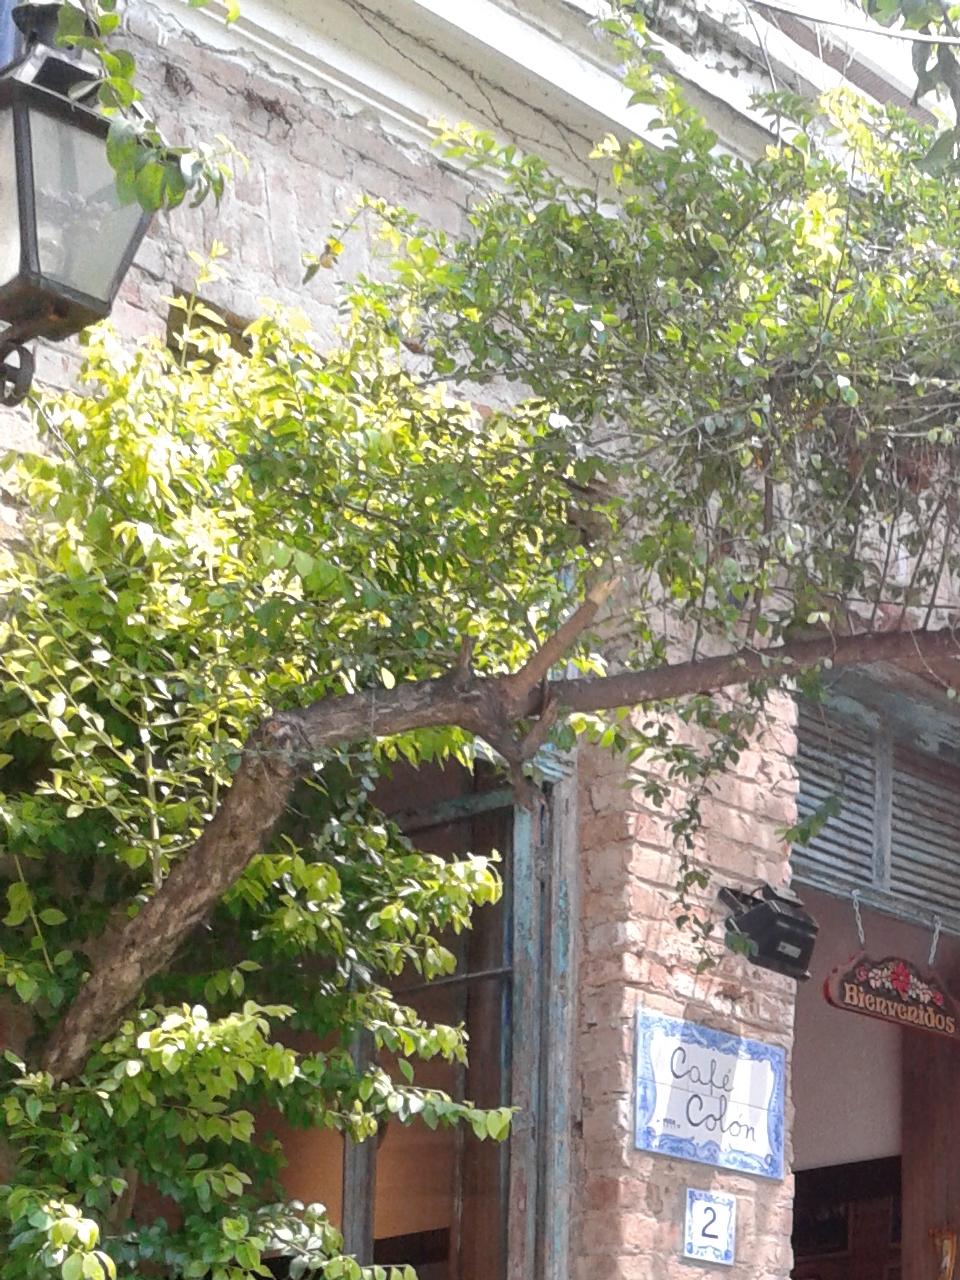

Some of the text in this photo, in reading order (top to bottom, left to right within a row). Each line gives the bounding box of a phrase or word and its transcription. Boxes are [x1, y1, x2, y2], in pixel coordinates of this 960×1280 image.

[843, 981, 955, 1034] Bienvenidos
[671, 1046, 734, 1096] Café
[686, 1094, 756, 1142] Colón
[700, 1205, 719, 1239] 2
